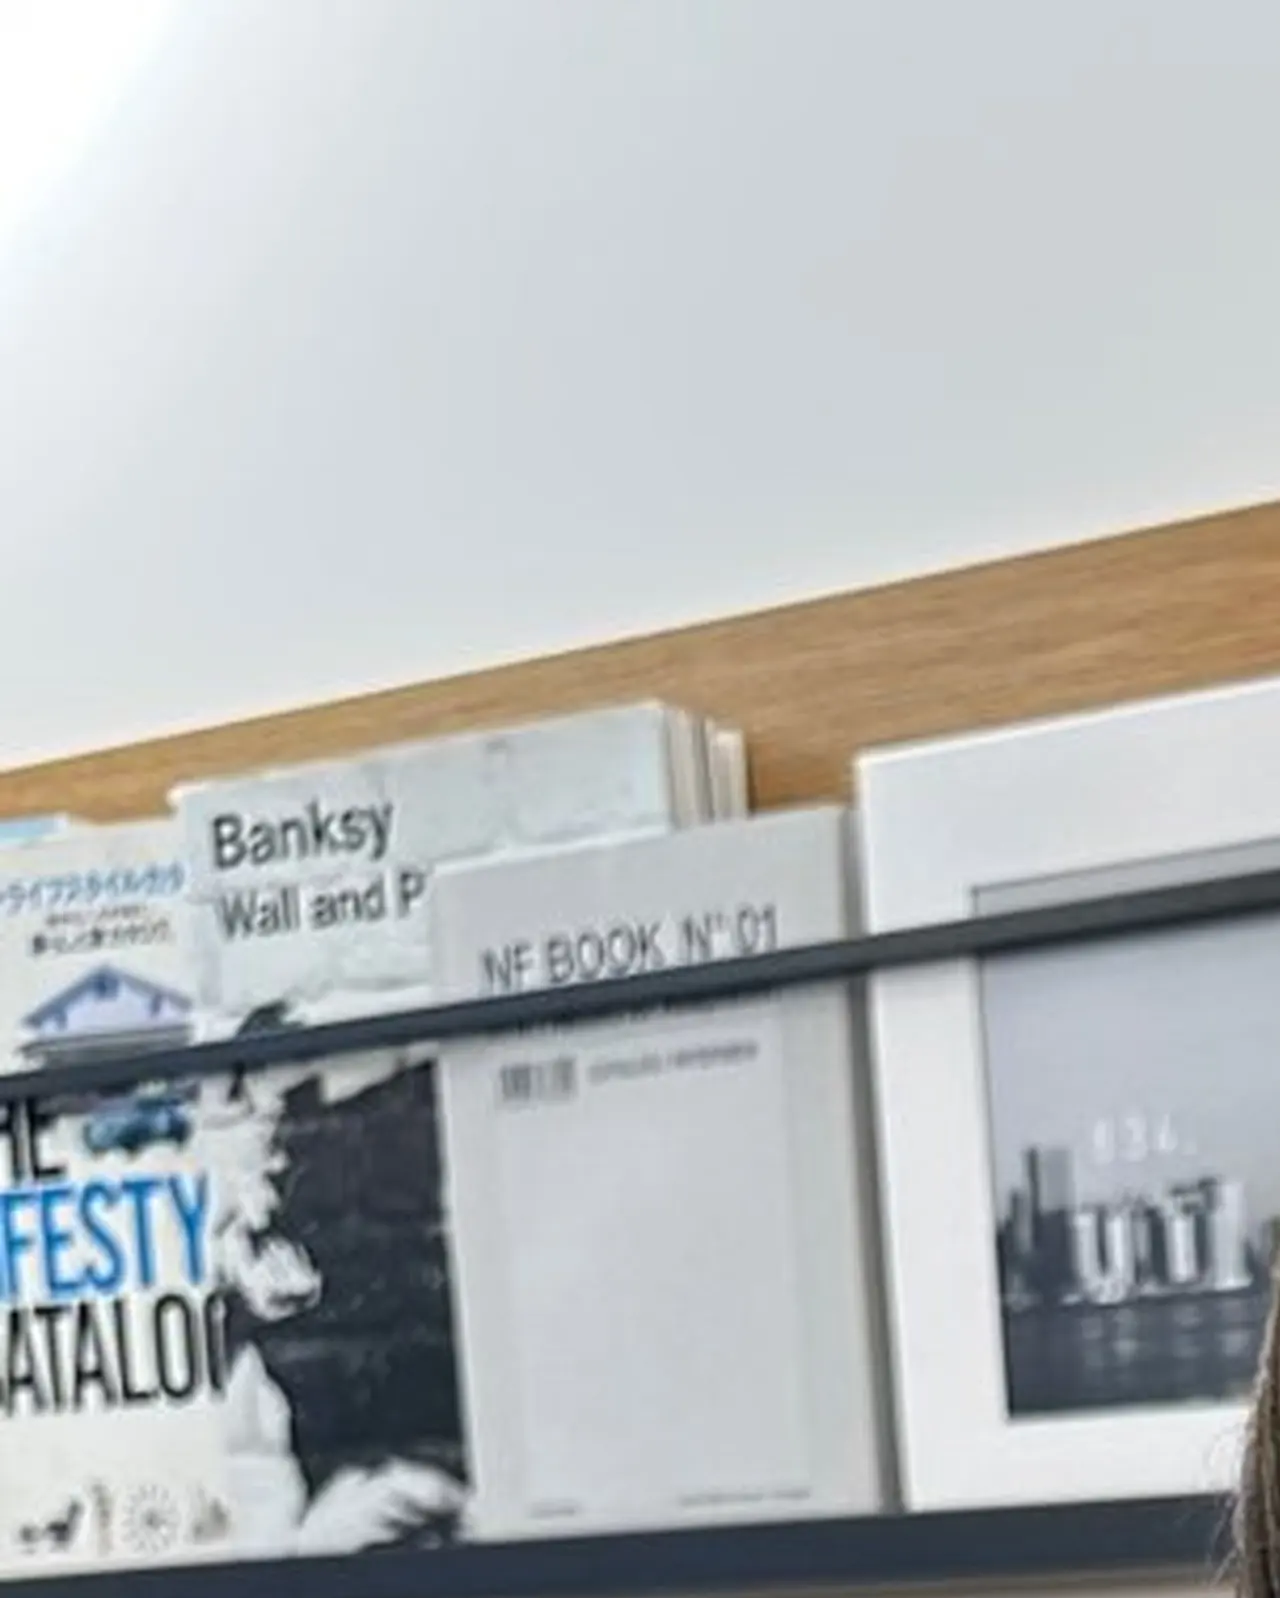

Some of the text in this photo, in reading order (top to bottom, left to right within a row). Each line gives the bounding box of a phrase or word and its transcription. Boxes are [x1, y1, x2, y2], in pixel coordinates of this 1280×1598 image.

[213, 800, 394, 871] Banksy
[220, 885, 301, 942] Wall
[312, 876, 386, 931] and
[479, 938, 534, 996] NF
[545, 920, 663, 985] BOOK
[736, 902, 778, 955] 01
